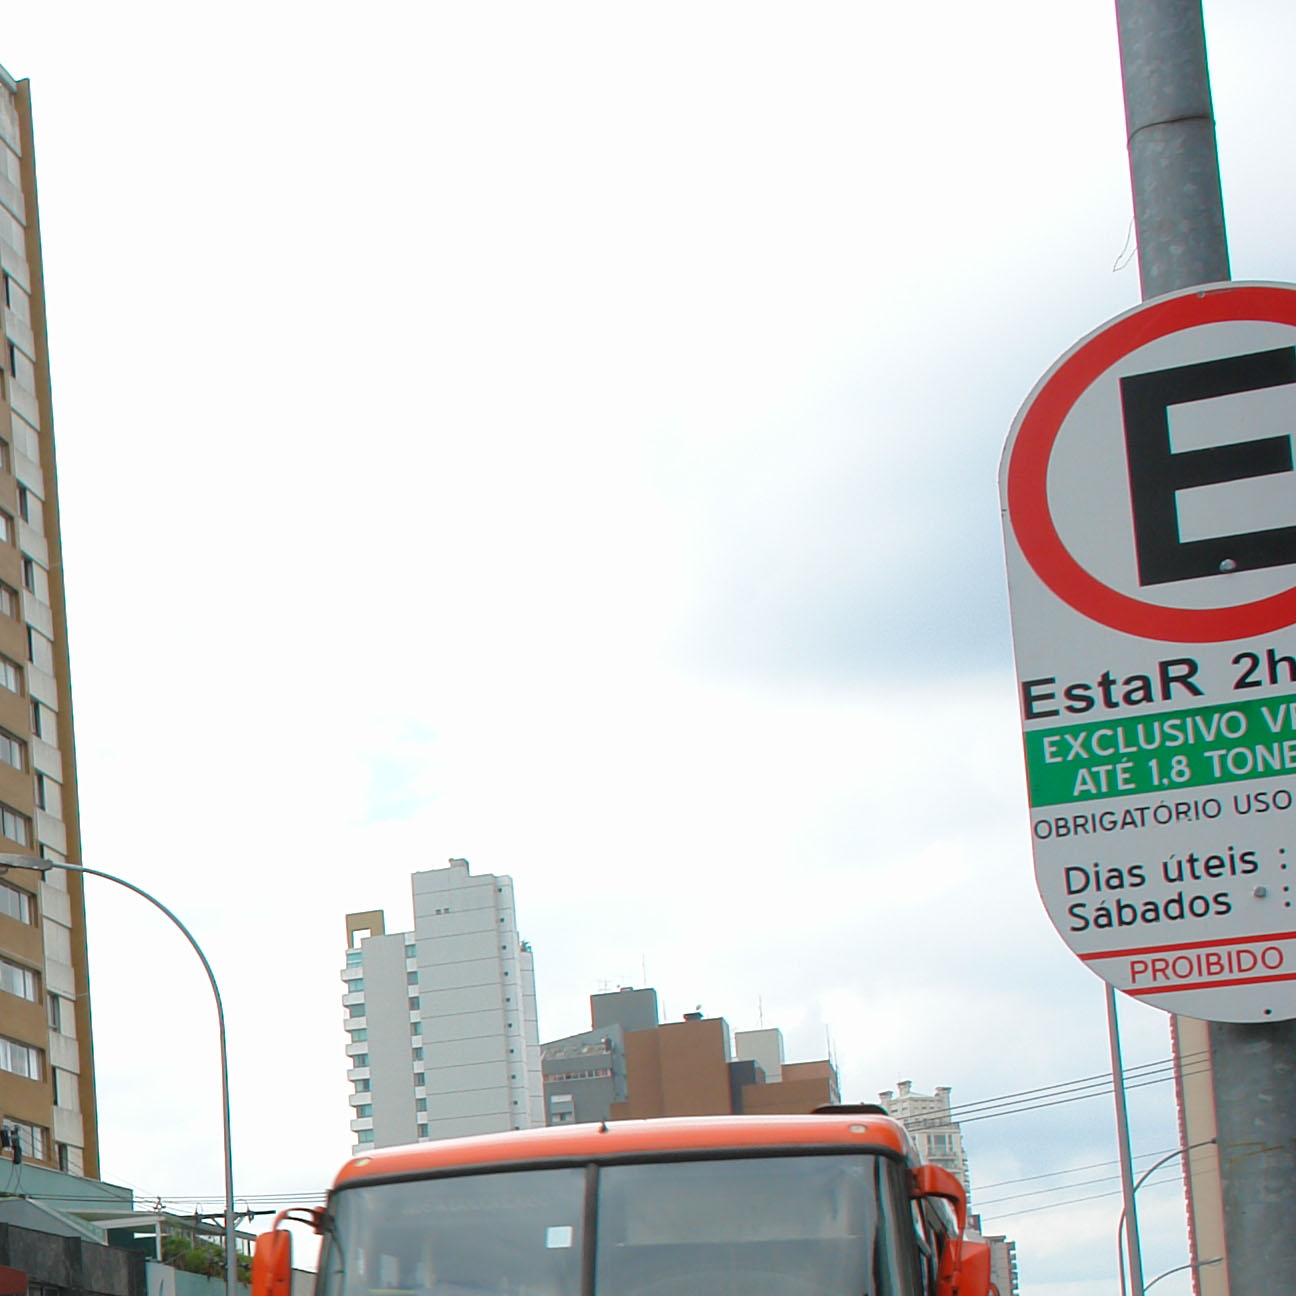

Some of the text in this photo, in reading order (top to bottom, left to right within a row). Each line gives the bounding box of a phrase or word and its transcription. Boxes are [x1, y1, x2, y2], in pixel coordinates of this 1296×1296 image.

[1119, 345, 1296, 587] E
[1021, 657, 1205, 722] EstaR
[1042, 710, 1248, 764] EXCLUSIVO
[1073, 757, 1136, 796] ATÉ
[1148, 754, 1192, 788] 1,8
[1034, 789, 1293, 840] OBRIGATÓRIO USO
[1063, 846, 1259, 896] Dias úteis
[1067, 889, 1233, 932] Sábados
[1130, 946, 1285, 985] PROIBIDO
